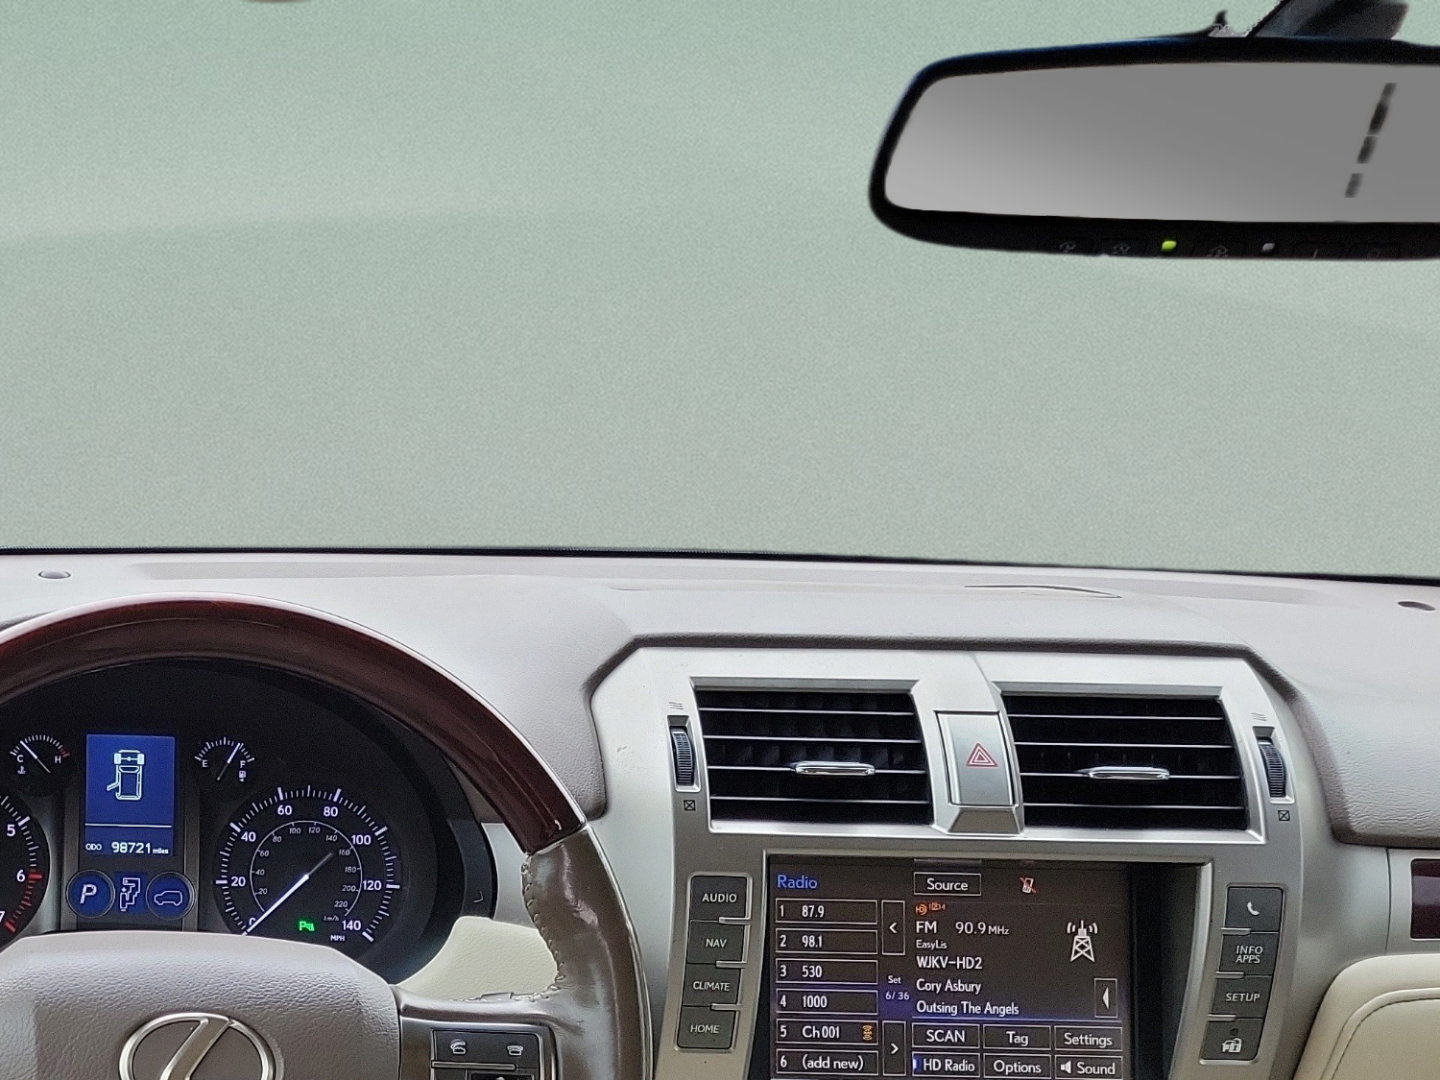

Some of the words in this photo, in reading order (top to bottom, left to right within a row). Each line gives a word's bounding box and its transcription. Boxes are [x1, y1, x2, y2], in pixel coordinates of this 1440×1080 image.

[16, 754, 24, 763] C
[54, 755, 62, 764] H
[201, 759, 209, 768] E
[240, 760, 247, 769] F
[277, 804, 293, 816] 60
[323, 805, 339, 818] 80
[6, 824, 16, 837] 5
[241, 831, 257, 842] 40
[351, 834, 372, 846] 100
[85, 843, 102, 852] ODO
[111, 842, 152, 855] 98721
[16, 869, 26, 882] 6
[231, 876, 246, 888] 20
[776, 874, 818, 889] Radio
[363, 880, 382, 891] 120
[926, 877, 969, 892] Source
[79, 884, 97, 904] P
[702, 892, 738, 903] AUDIO
[779, 906, 785, 918] 1
[801, 905, 826, 918] 87.9
[342, 920, 362, 931] 140
[915, 920, 938, 934] FM
[955, 921, 987, 935] 90.9
[988, 925, 1010, 935] MHz
[330, 934, 346, 942] MPH
[705, 938, 727, 948] NAV
[779, 935, 787, 947] 2
[801, 935, 823, 948] 98.1
[1235, 945, 1264, 955] INFO
[916, 955, 983, 970] WJKV-HD2
[1235, 954, 1261, 964] APPS
[779, 965, 787, 977] 3
[801, 965, 823, 978] 530
[887, 975, 902, 984] Set
[692, 981, 731, 992] CLIMATE
[916, 978, 942, 994] Cory
[944, 978, 982, 995] Asbury
[779, 995, 787, 1008] 4
[802, 995, 828, 1008] 1000
[1225, 992, 1261, 1002] SETUP
[916, 1000, 958, 1017] Outsing
[960, 1000, 982, 1014] The
[984, 1001, 1020, 1018] Angels
[689, 1024, 720, 1034] HOME
[779, 1025, 787, 1038] 5
[926, 1029, 966, 1044] SCAN
[1006, 1031, 1029, 1047] Tag
[1063, 1032, 1113, 1049] Settings
[780, 1055, 788, 1068] 6
[801, 1055, 830, 1071] (add
[833, 1055, 864, 1071] new)
[922, 1058, 942, 1071] HD
[944, 1059, 976, 1072] Radio
[993, 1059, 1042, 1075] Options
[1076, 1061, 1116, 1076] Sound
